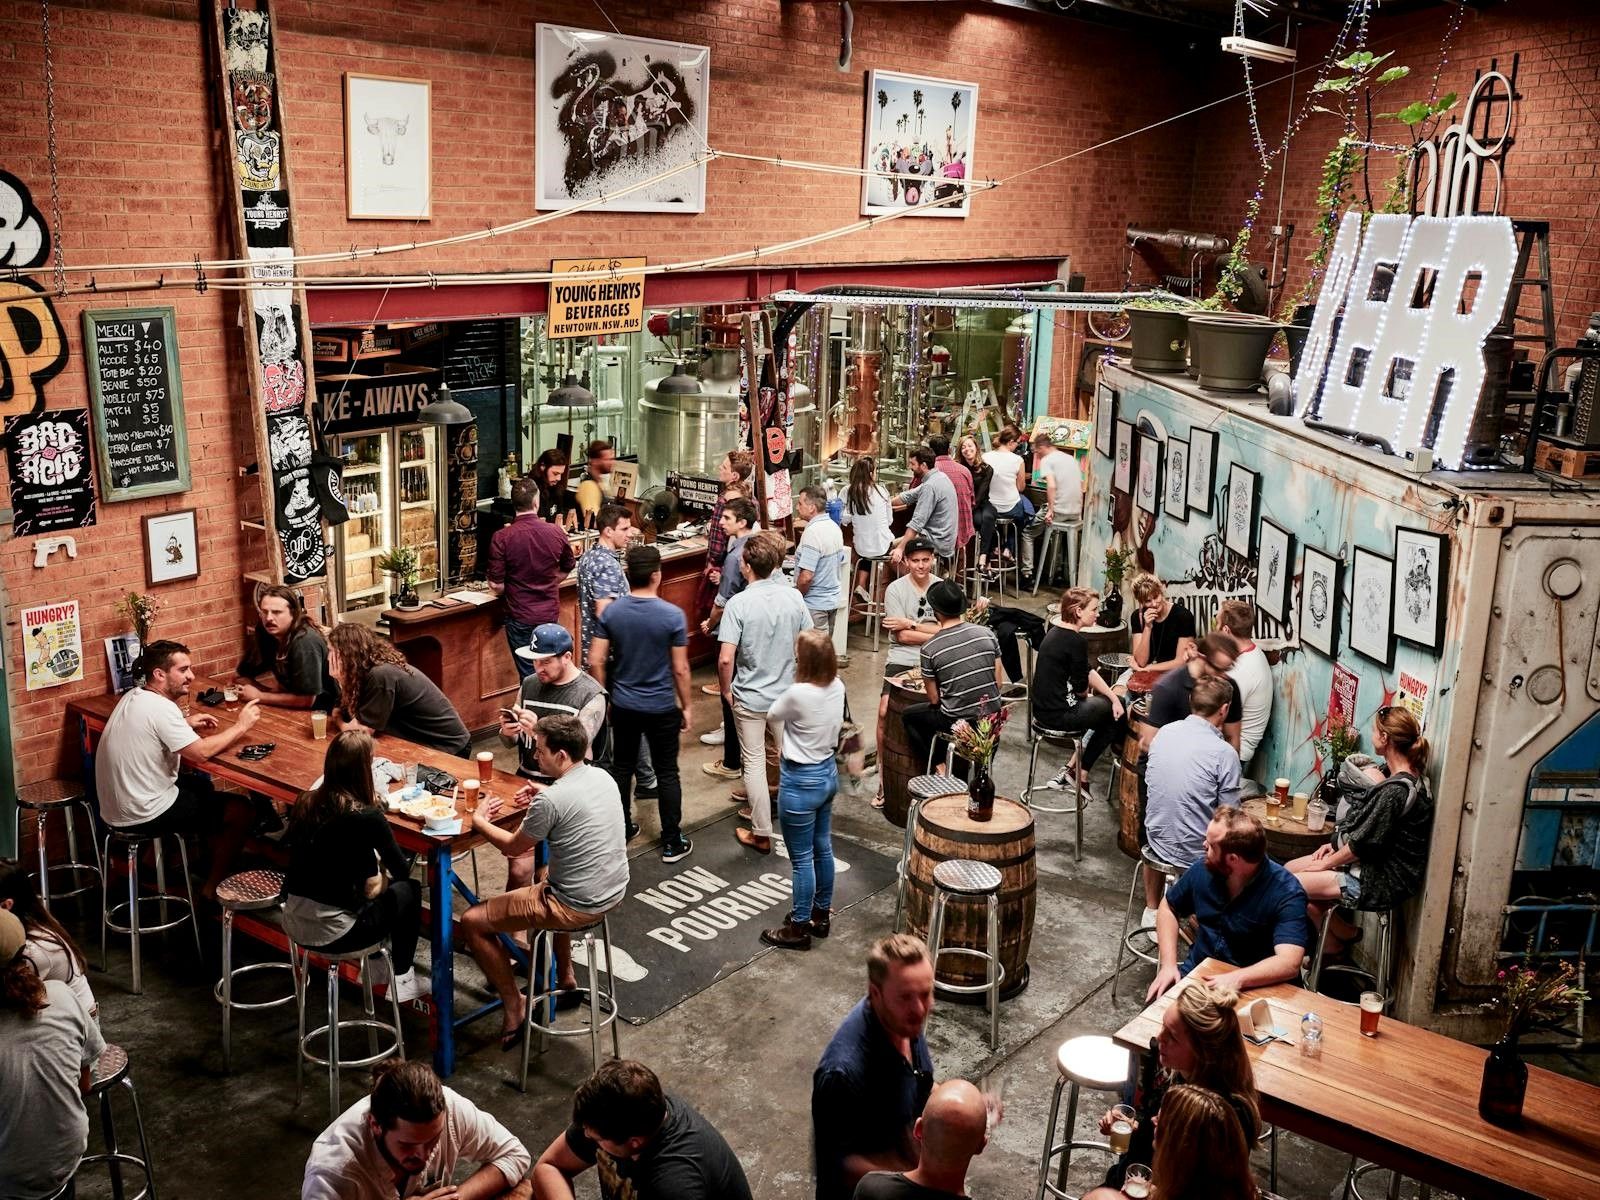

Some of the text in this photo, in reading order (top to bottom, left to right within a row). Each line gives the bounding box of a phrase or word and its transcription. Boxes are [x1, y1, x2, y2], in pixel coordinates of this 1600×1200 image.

[246, 210, 287, 219] YOUNG HENRYS
[555, 282, 641, 304] YOUNG HENRYS
[565, 303, 630, 321] BEVERAGES
[96, 323, 135, 338] MERCH
[98, 344, 114, 355] ALL
[134, 339, 162, 353] $40
[99, 353, 159, 366] HOODIE $65
[101, 365, 163, 379] TOTE BAG $20
[101, 377, 158, 392] BEANIE $50
[102, 387, 166, 405] NOBLE CUT $75
[323, 383, 429, 422] KE-AWAYS
[104, 402, 160, 417] PATCH $5
[142, 413, 160, 425] $5
[156, 437, 171, 450] $7
[109, 455, 142, 469] HANDSOME
[680, 478, 719, 493] YOUNG HENRYS
[692, 501, 705, 510] HERE
[25, 604, 76, 627] HUNGRY?
[1400, 671, 1428, 701] HUNGRY?
[633, 865, 731, 915] NOW
[646, 872, 794, 953] POURING
